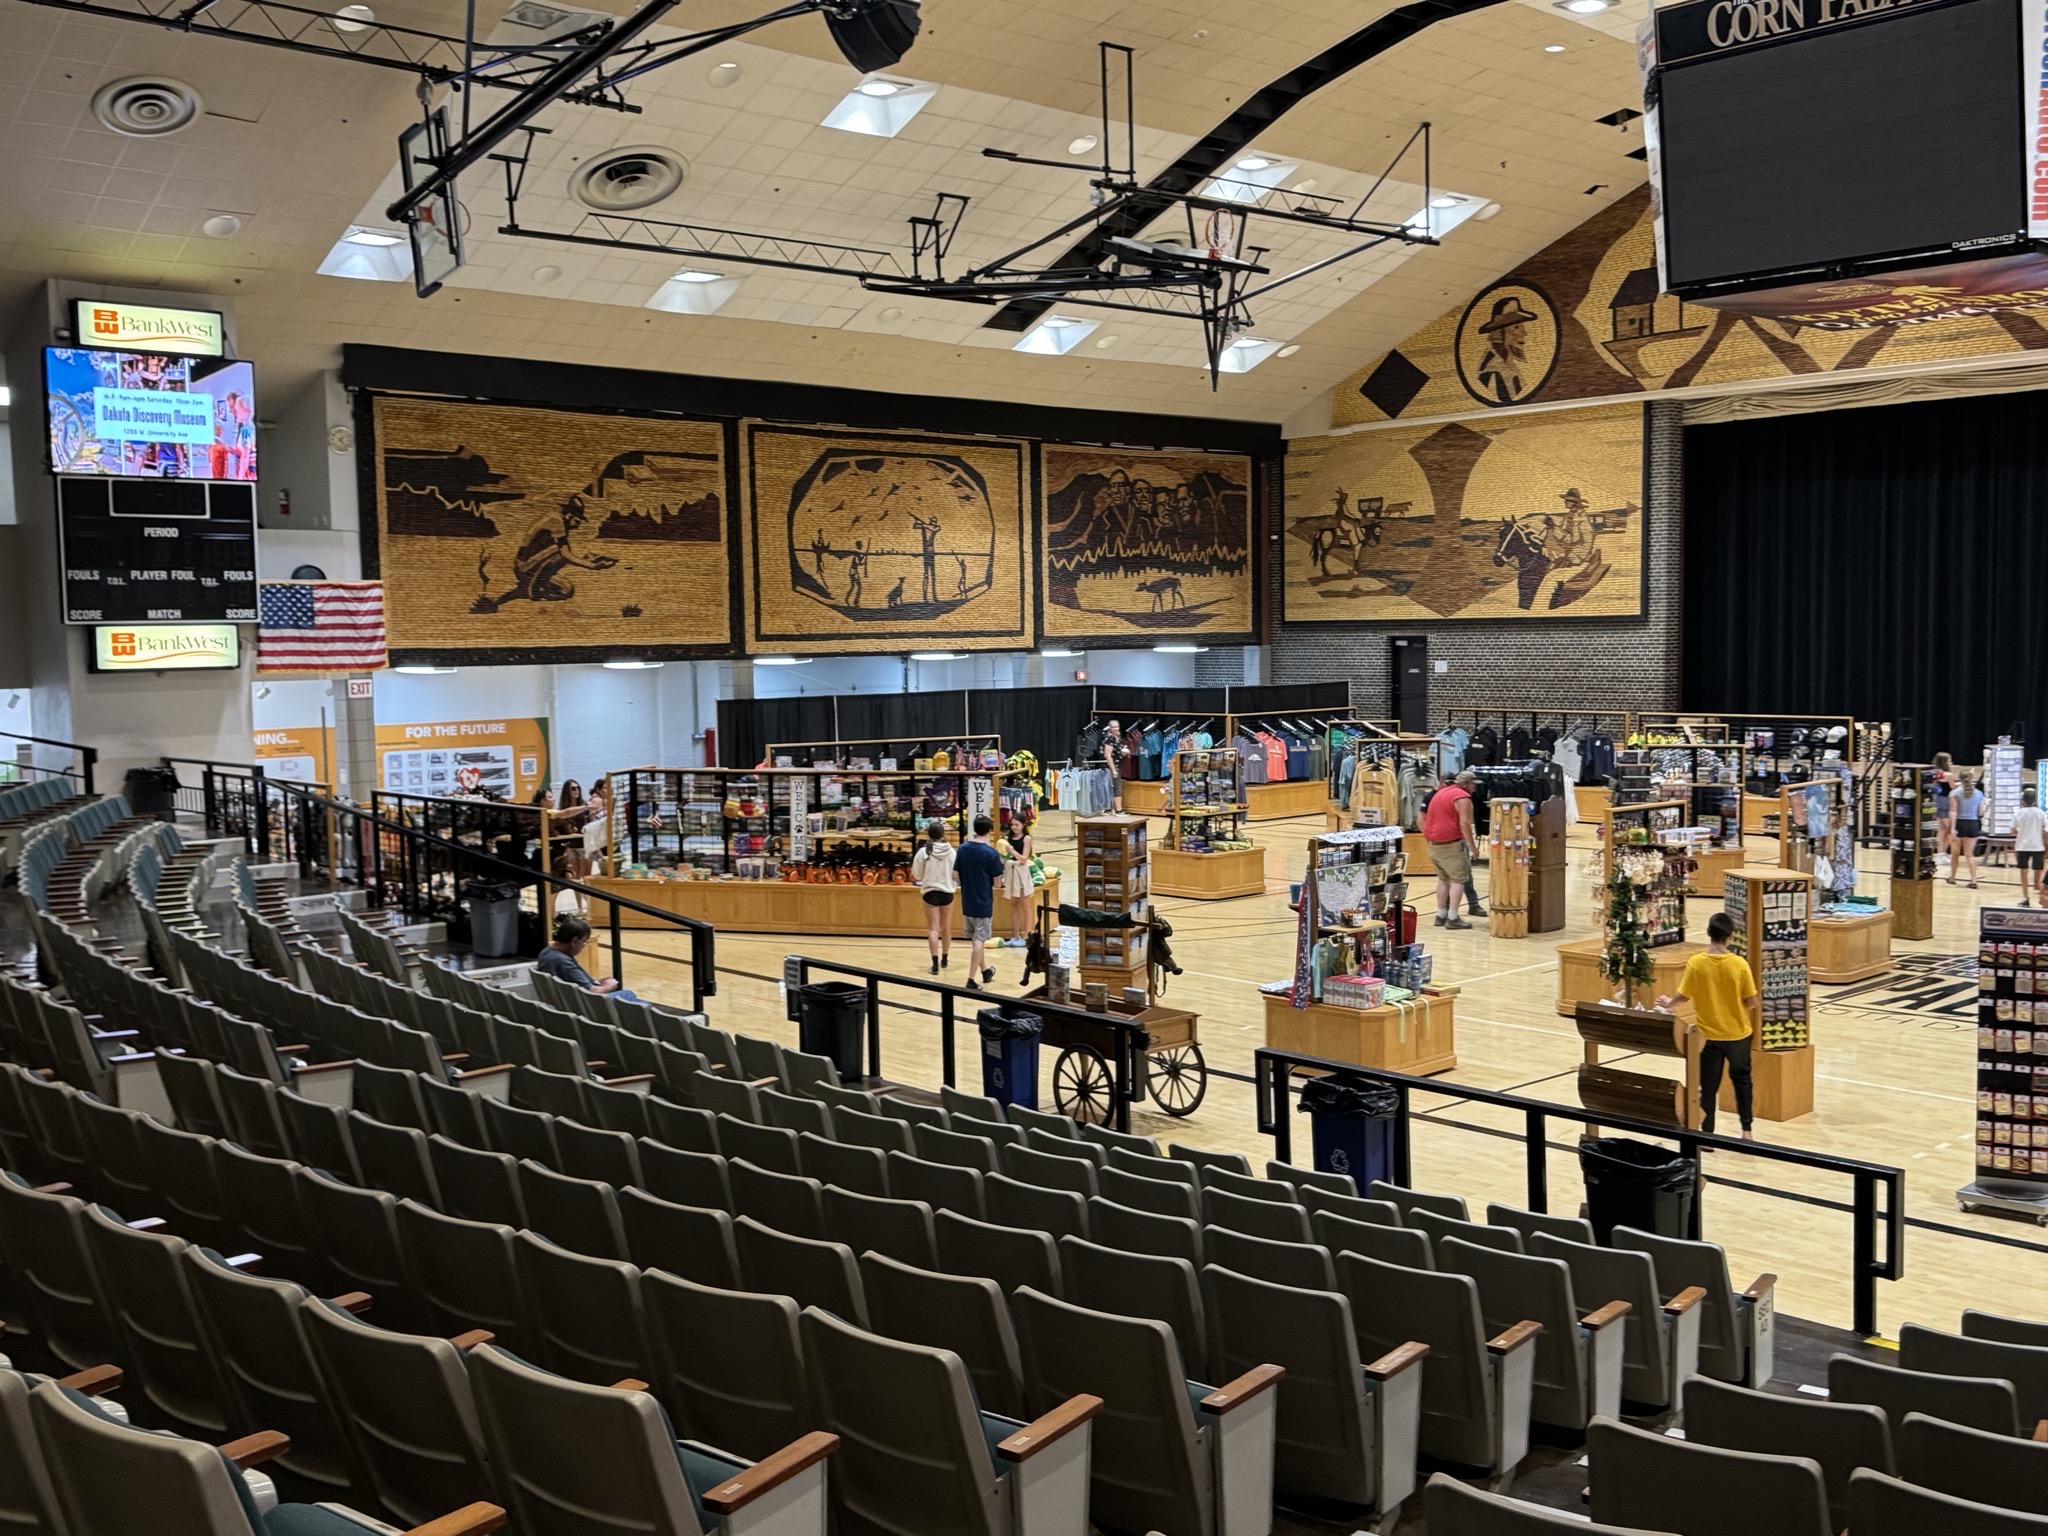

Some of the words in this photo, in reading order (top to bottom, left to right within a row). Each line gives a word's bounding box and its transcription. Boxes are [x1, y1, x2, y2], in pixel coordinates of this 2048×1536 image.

[1706, 0, 1805, 47] CORN
[1952, 233, 2017, 249] DAKTRONICS
[121, 316, 214, 338] BankWest
[102, 405, 131, 422] Dakota
[132, 406, 172, 427] Discovery
[173, 409, 207, 426] Museum
[143, 527, 179, 538] PERIOD
[67, 570, 100, 580] FOULS
[130, 570, 168, 581] PLAYER
[171, 570, 197, 581] FOUL
[223, 570, 254, 581] FOULS
[70, 609, 103, 620] SCORE
[147, 609, 182, 619] MATCH
[226, 609, 257, 619] SCORE
[138, 635, 230, 651] BankWest
[350, 682, 371, 695] EXIT
[405, 726, 431, 739] FOR
[434, 725, 458, 737] THE
[460, 723, 506, 735] FUTURE
